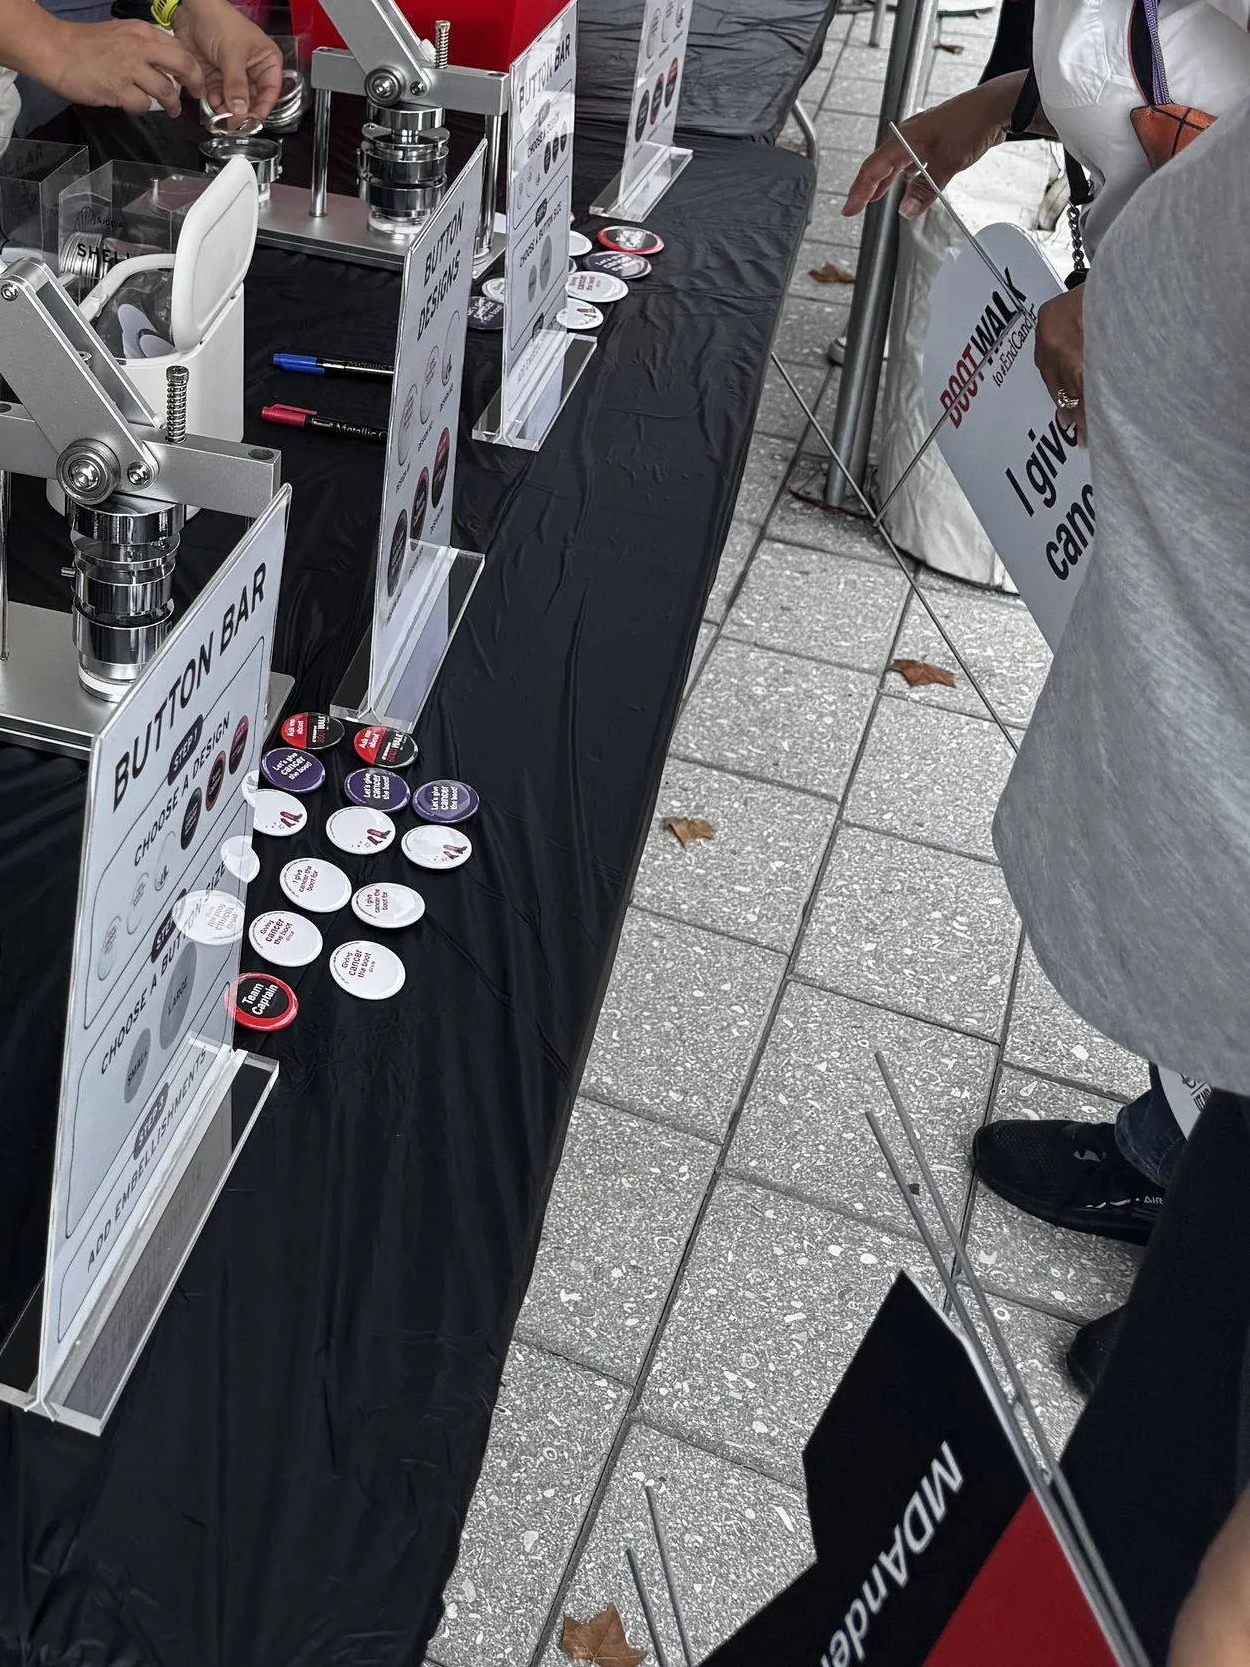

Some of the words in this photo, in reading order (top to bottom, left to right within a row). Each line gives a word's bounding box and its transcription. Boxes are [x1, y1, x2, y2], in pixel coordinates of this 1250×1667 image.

[519, 54, 553, 114] BUTTON
[554, 32, 571, 74] BAR
[424, 201, 465, 288] BUTTON
[417, 249, 461, 342] DESIGNS
[336, 421, 376, 439] Metallic
[1005, 467, 1034, 518] I
[113, 630, 215, 813] BUTTON
[220, 562, 267, 657] BAR
[173, 735, 193, 772] STEP
[272, 758, 285, 771] Let's
[285, 751, 298, 763] give
[280, 756, 306, 776] cancer
[288, 771, 300, 780] the
[135, 787, 179, 868] CHOOSE
[181, 774, 190, 798] A
[193, 711, 230, 781] DESIGN
[363, 783, 371, 798] Let's
[373, 774, 381, 799] cancer
[382, 789, 390, 800] the
[440, 785, 450, 810] cancer
[431, 796, 439, 811] Let's
[450, 799, 458, 810] the
[259, 919, 275, 936] Giving
[265, 918, 285, 943] cancer
[273, 933, 284, 946] the
[279, 922, 293, 939] boot
[341, 951, 354, 969] Giving
[349, 949, 363, 977] cancer
[357, 965, 366, 979] the
[360, 952, 371, 970] boot
[101, 1001, 148, 1076] CHOOSE
[150, 972, 158, 998] A
[161, 898, 202, 977] BUTTON
[241, 982, 264, 1006] Team
[251, 983, 279, 1016] Captain
[87, 1218, 113, 1274] ADD
[114, 1045, 207, 1227] EMBELLISHMENTS
